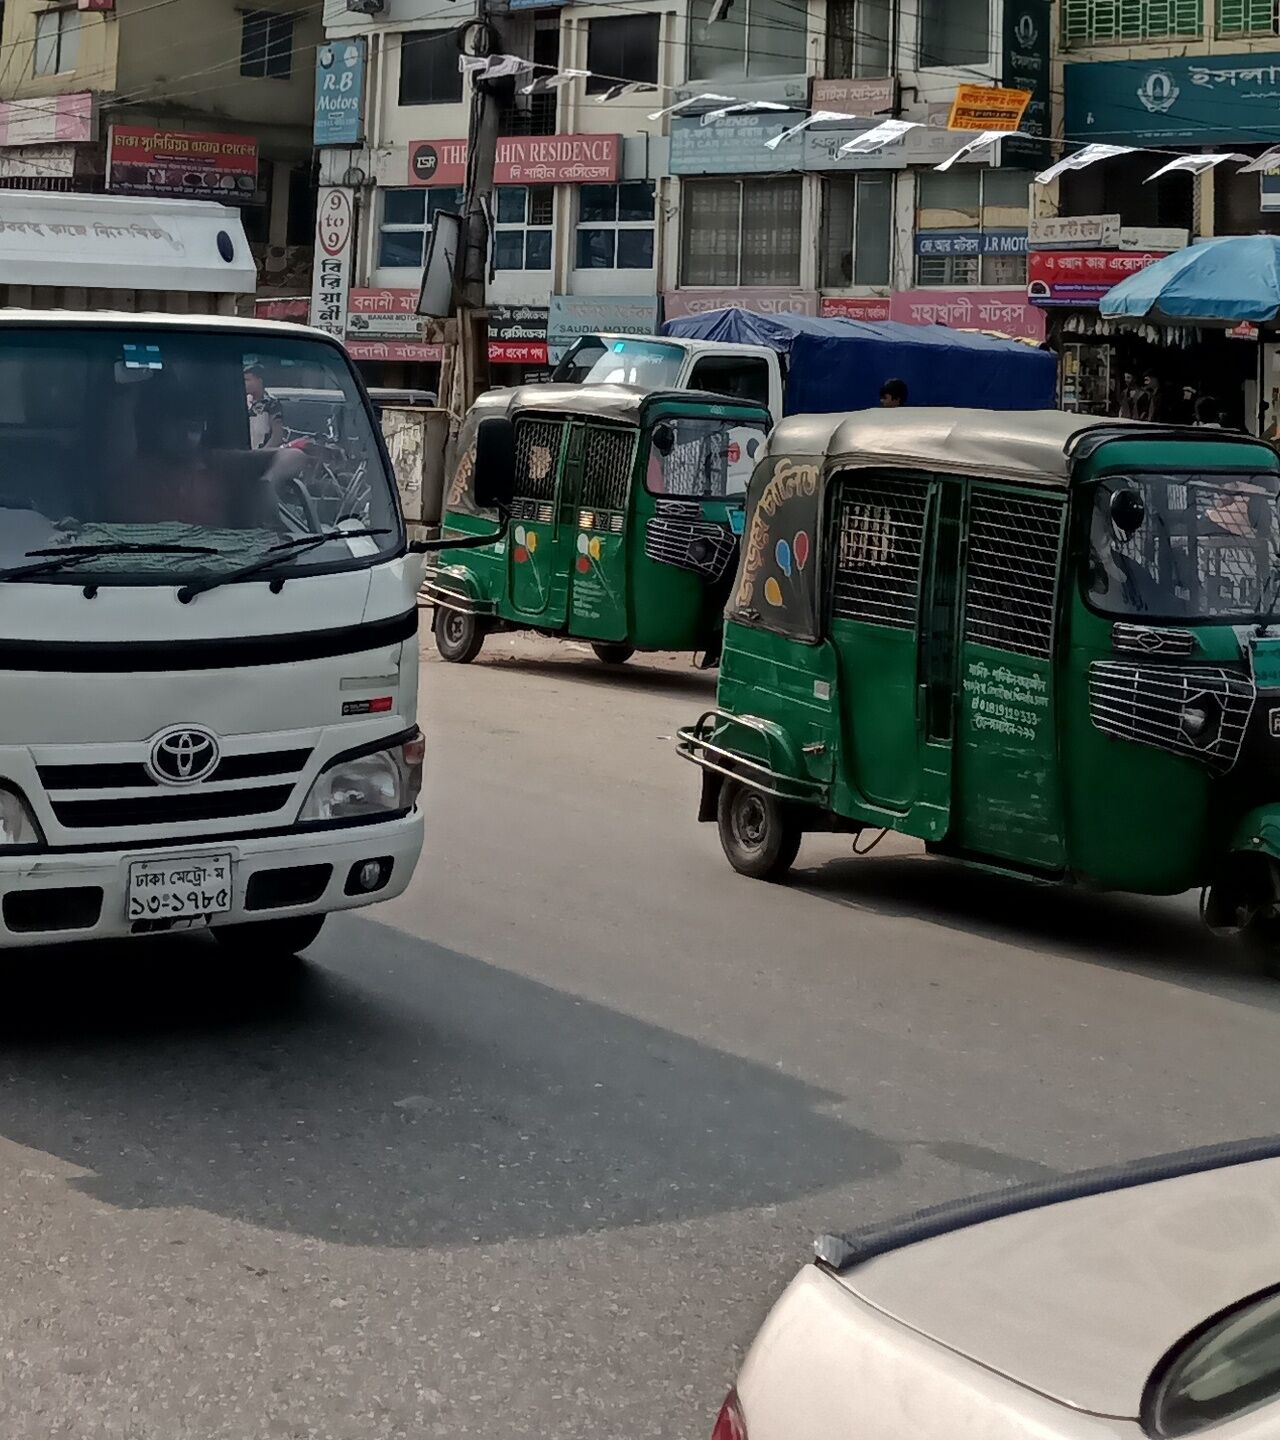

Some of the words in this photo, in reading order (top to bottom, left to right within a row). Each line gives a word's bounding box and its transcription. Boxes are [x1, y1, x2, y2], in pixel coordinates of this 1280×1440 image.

[318, 94, 358, 112] Motors
[530, 140, 612, 162] RESIDENCE
[354, 290, 394, 311] বনানী
[910, 298, 972, 323] মহাখালী
[978, 303, 1025, 324] মটরস
[559, 324, 602, 334] SAUDIA
[603, 324, 652, 335] MOTORS
[135, 872, 165, 887] ঢাকা
